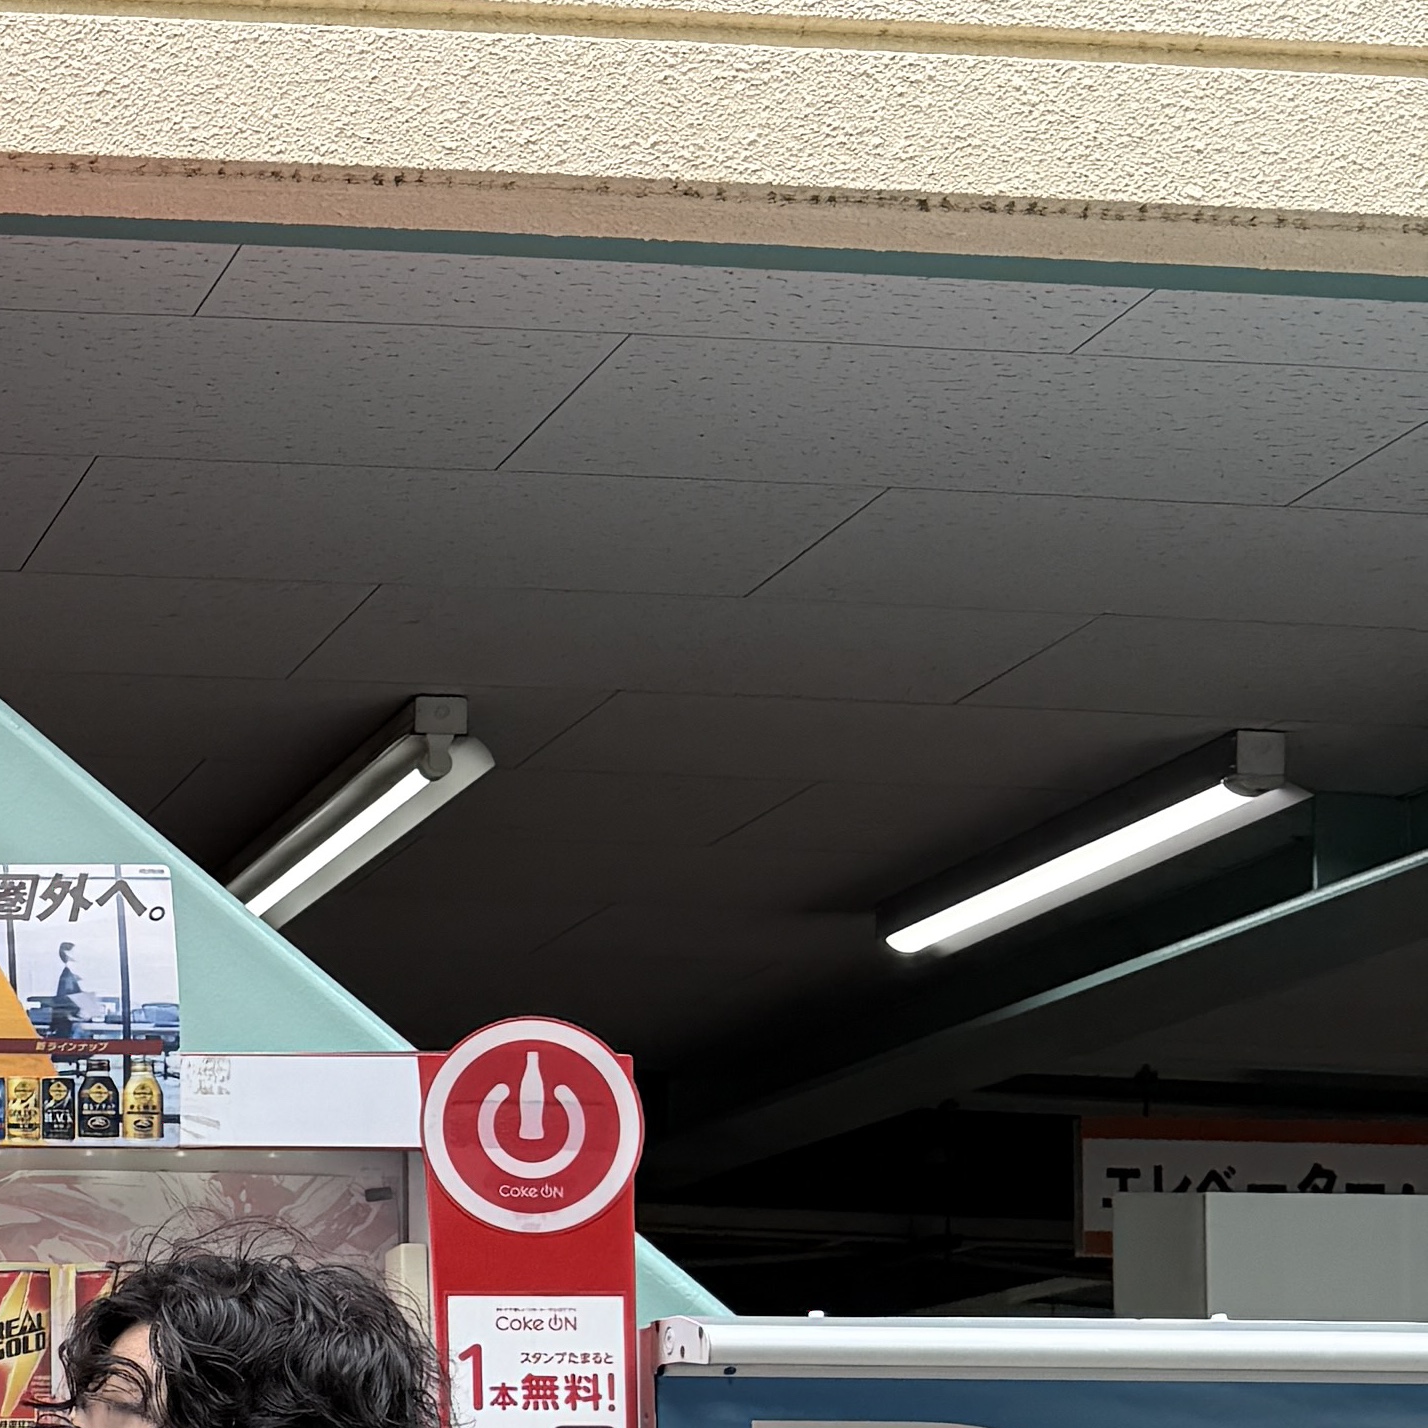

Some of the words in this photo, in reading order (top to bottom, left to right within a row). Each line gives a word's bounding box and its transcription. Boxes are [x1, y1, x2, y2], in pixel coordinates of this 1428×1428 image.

[499, 1184, 538, 1198] Coke
[540, 1183, 564, 1198] ON
[520, 1352, 614, 1365] スタンプたまると
[458, 1343, 616, 1411] 1本無料!
